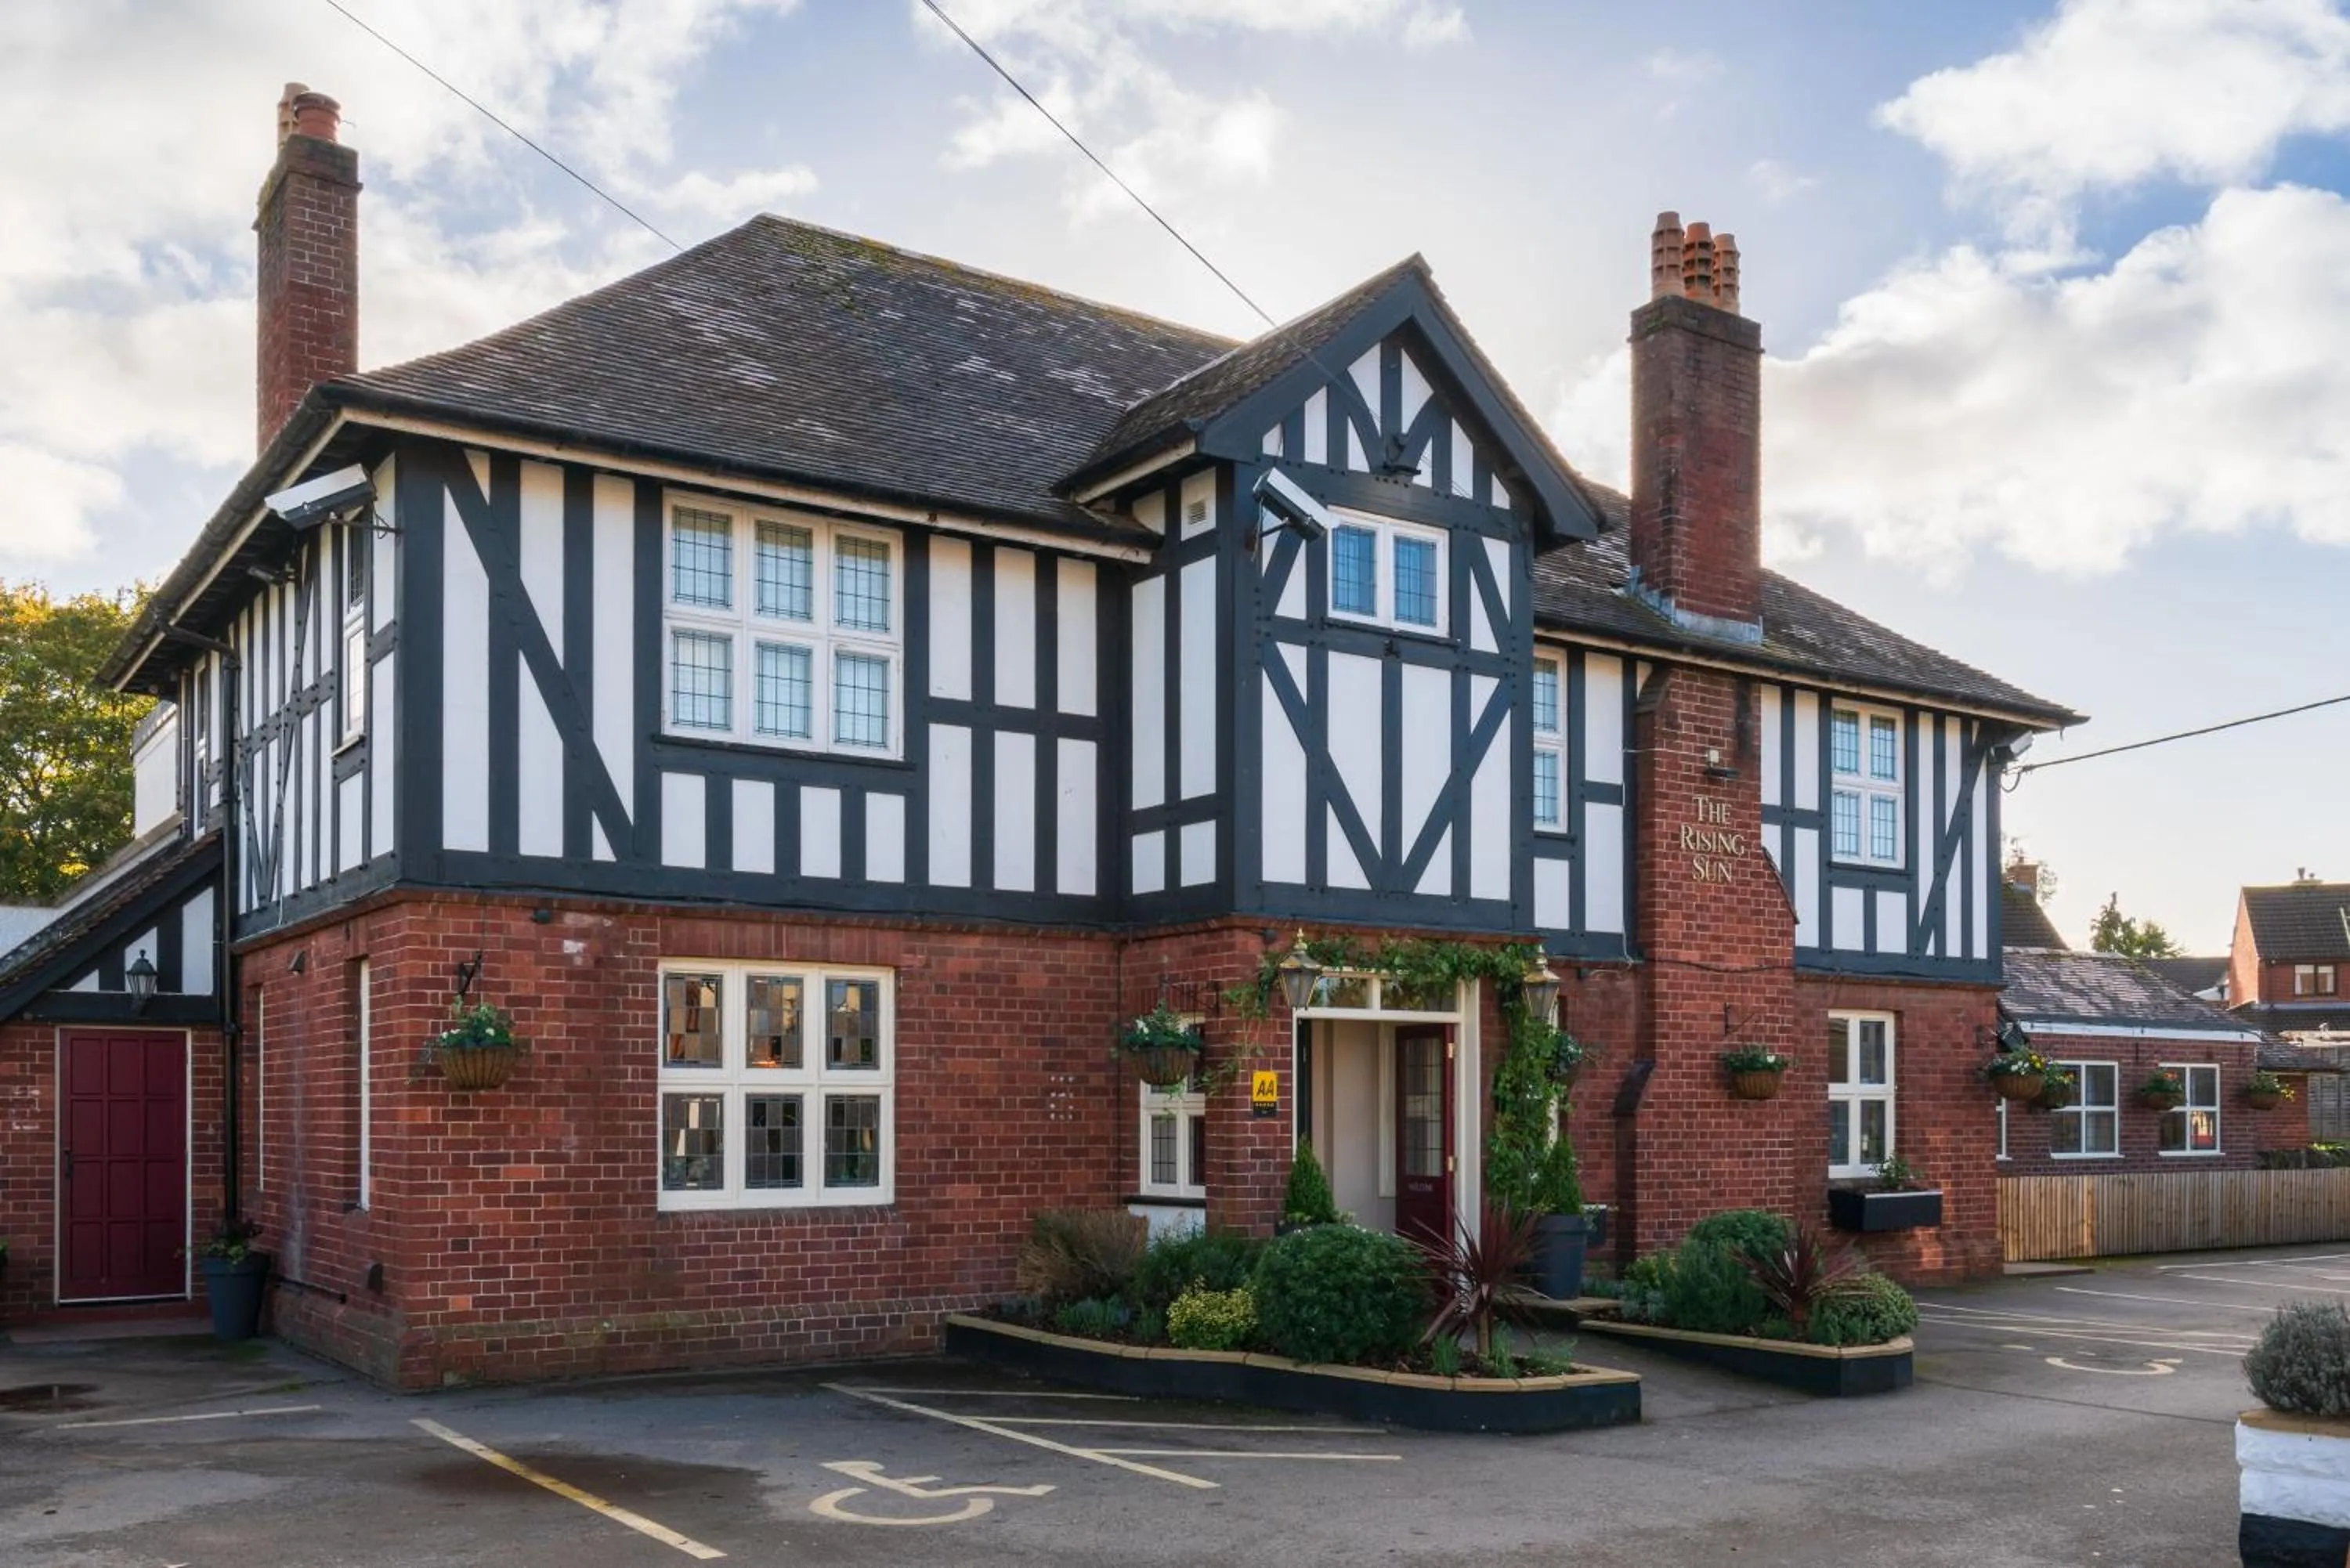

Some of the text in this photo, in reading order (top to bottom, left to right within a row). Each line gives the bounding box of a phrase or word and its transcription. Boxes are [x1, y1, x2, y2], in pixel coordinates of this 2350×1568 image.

[1693, 796, 1732, 823] THE
[1680, 824, 1744, 855] RISING
[1693, 854, 1732, 883] SUN
[1256, 1079, 1274, 1097] AA
